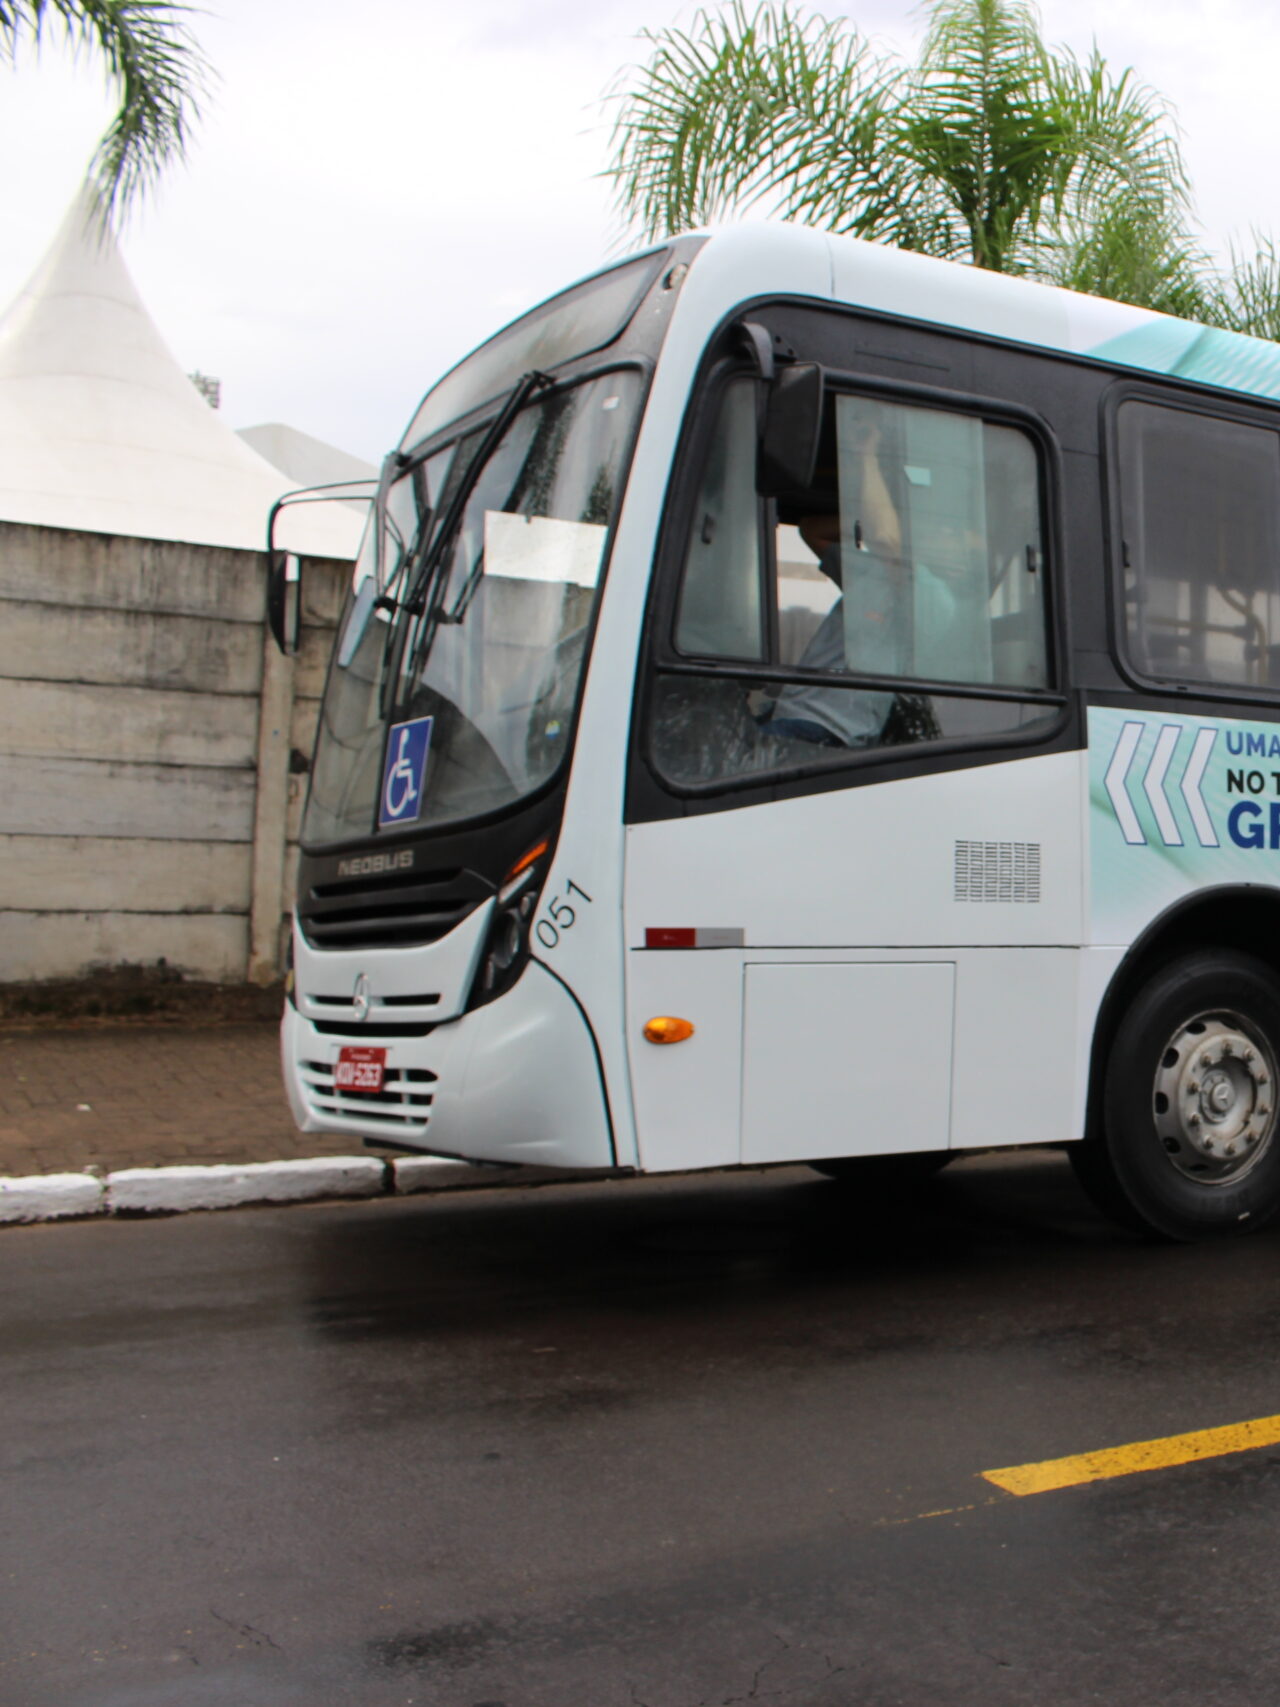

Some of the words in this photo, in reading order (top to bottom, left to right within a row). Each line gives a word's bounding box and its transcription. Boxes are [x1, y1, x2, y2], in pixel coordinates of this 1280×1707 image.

[1227, 769, 1265, 794] NO
[338, 850, 414, 877] NEOBUS
[535, 878, 593, 949] 051
